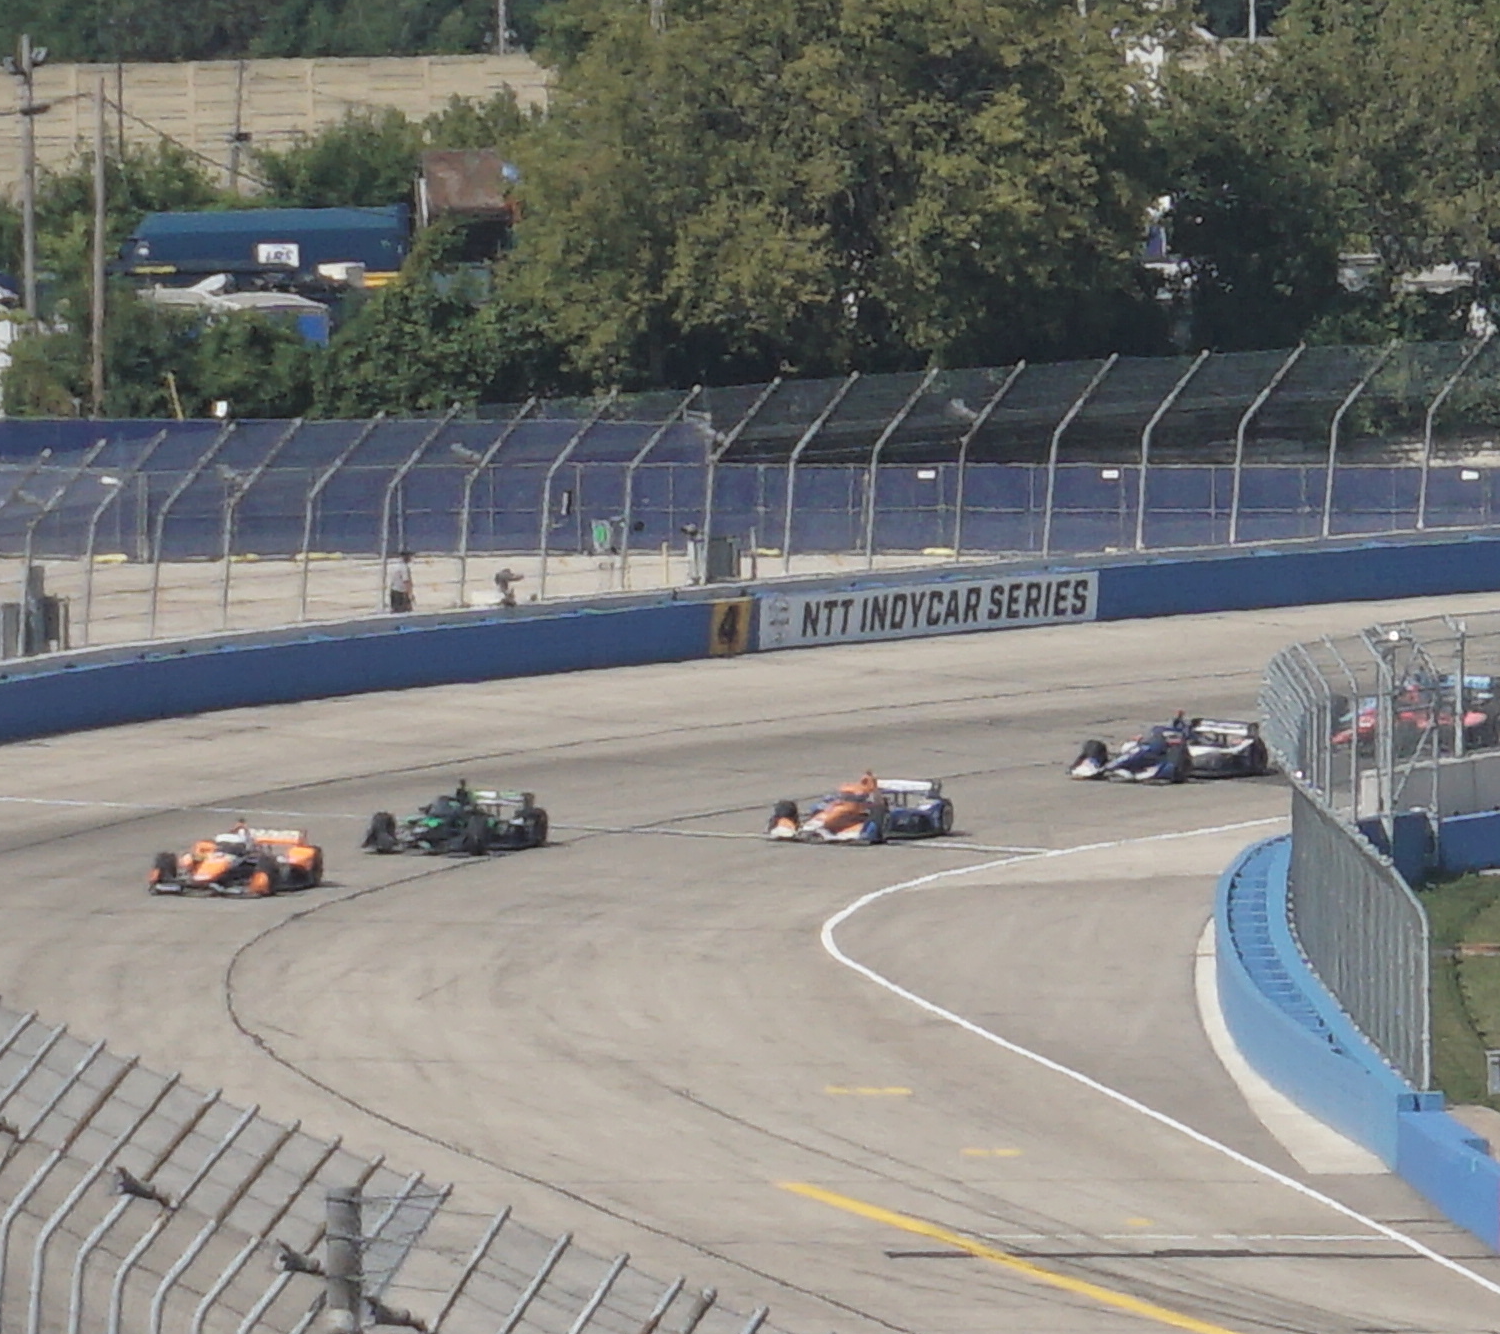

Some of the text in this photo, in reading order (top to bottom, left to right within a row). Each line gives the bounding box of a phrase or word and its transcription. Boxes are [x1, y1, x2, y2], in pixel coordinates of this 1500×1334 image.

[717, 605, 739, 650] 4
[801, 598, 855, 638] NTT
[860, 586, 982, 632] INDYCAR
[987, 578, 1090, 620] SERIES
